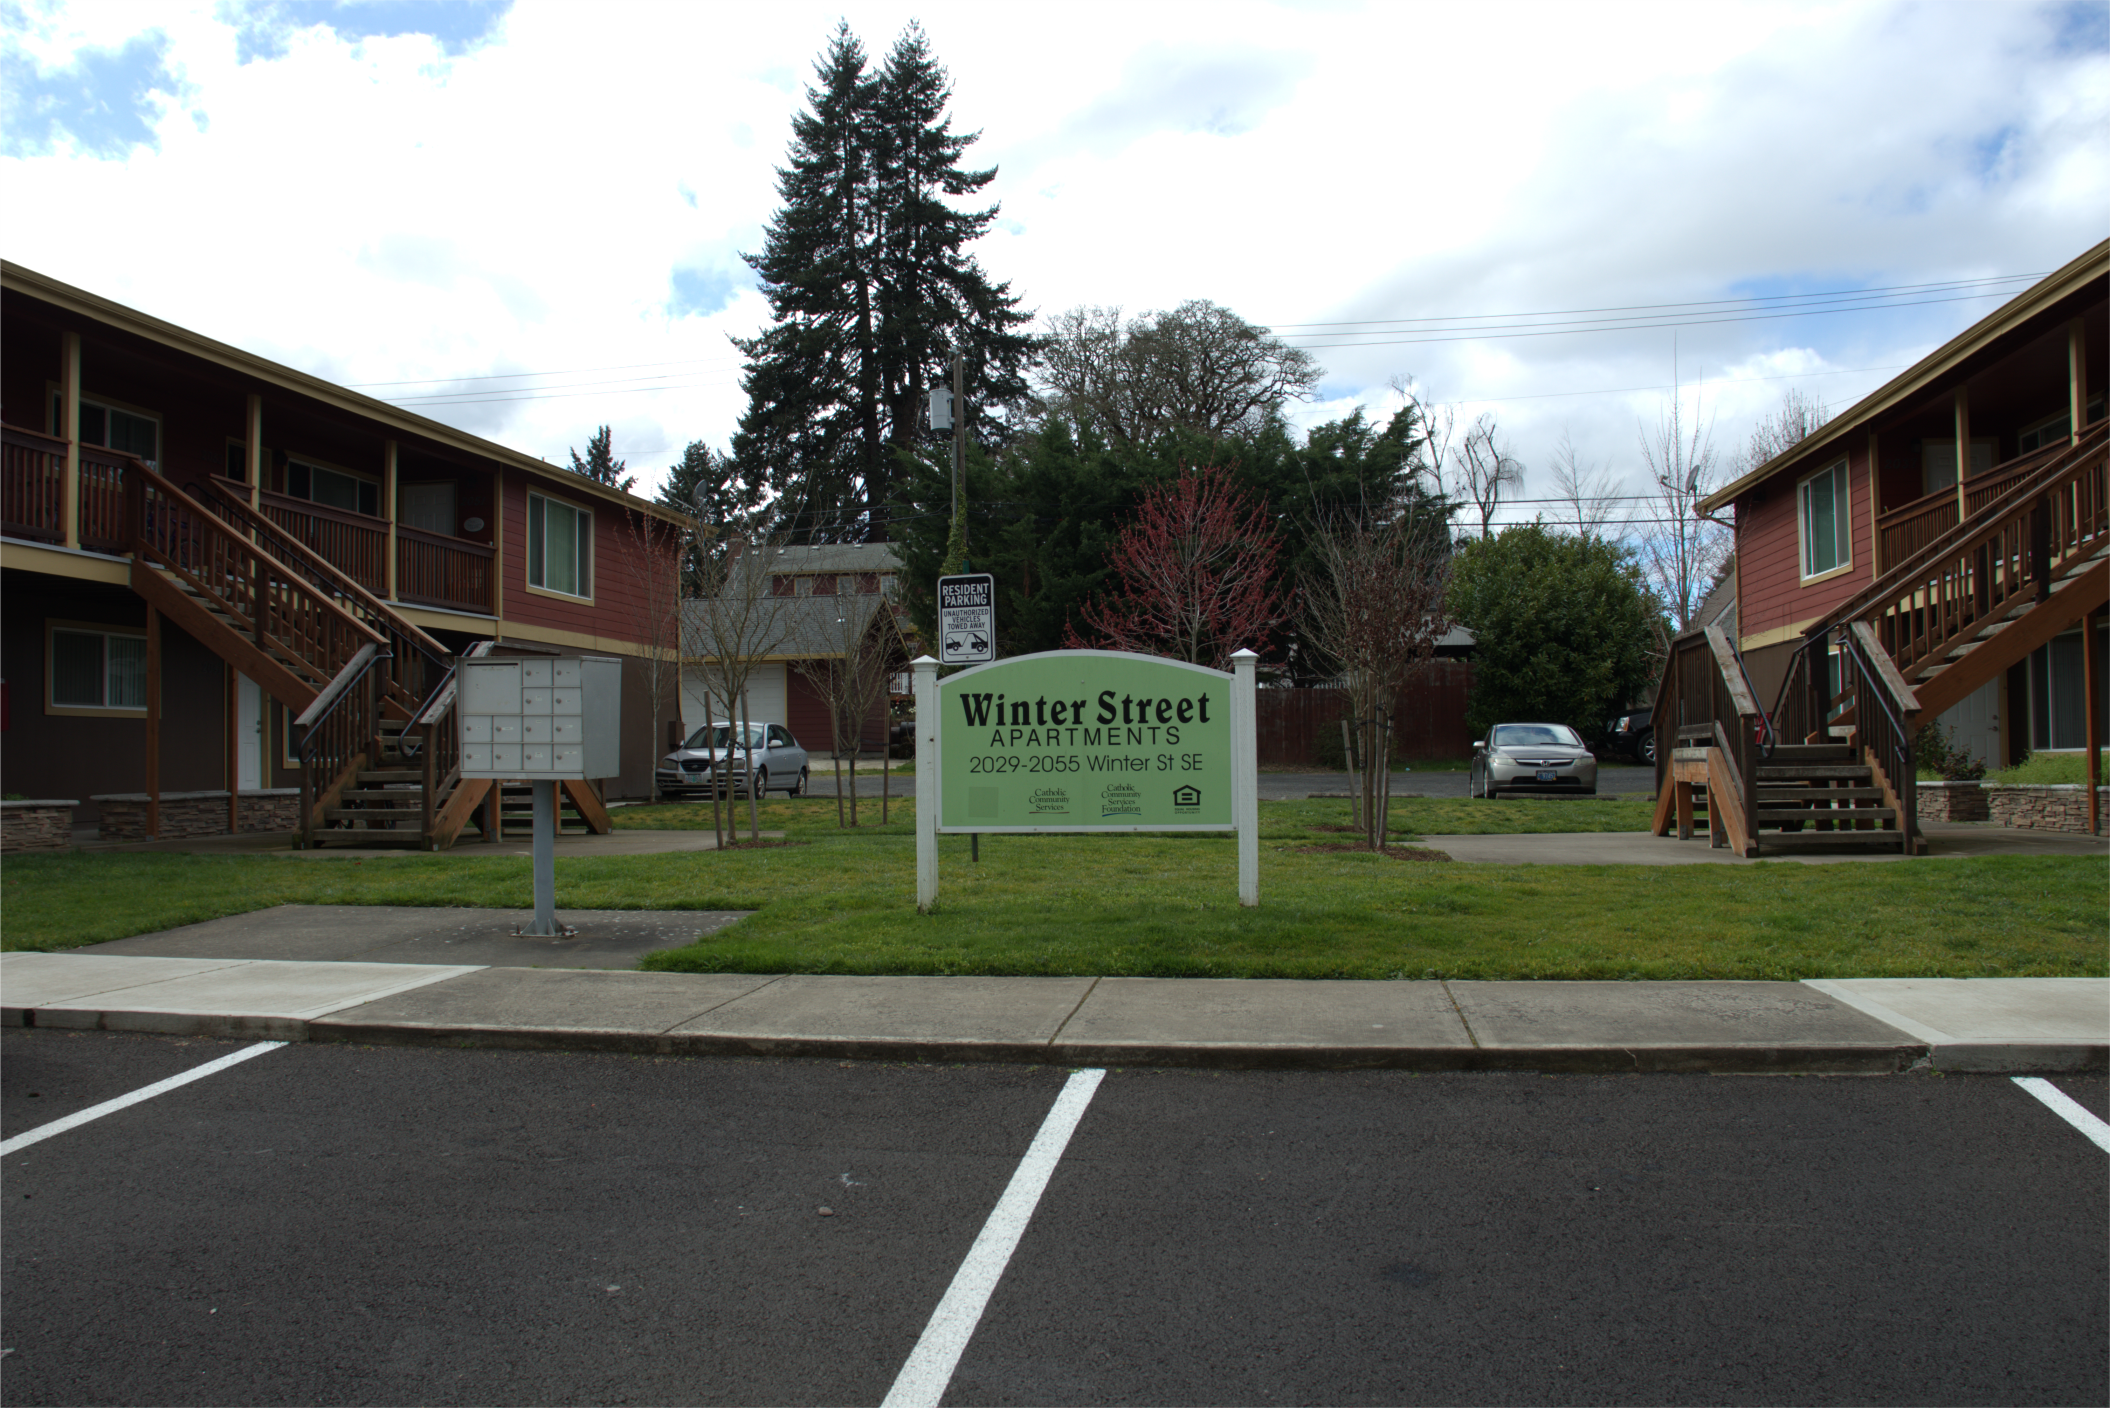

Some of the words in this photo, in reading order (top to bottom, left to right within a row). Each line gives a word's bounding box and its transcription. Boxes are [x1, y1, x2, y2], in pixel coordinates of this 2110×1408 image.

[942, 583, 989, 596] RESIDENT
[945, 594, 987, 606] PARKING
[943, 609, 989, 617] UNAUTHORIZED
[959, 692, 1088, 727] Winter
[1096, 690, 1211, 725] Street
[990, 726, 1180, 747] APARTMENTS
[969, 755, 1081, 774] 2029-2055
[1086, 754, 1151, 773] Winter
[1156, 753, 1174, 772] St
[1181, 753, 1203, 771] SE
[1106, 783, 1135, 792] Catholic
[1034, 788, 1067, 797] Catholic
[1101, 790, 1142, 800] Community
[1028, 796, 1070, 805] Community
[1107, 798, 1136, 806] Services
[1035, 803, 1065, 811] Services
[1101, 804, 1141, 813] Foundation
